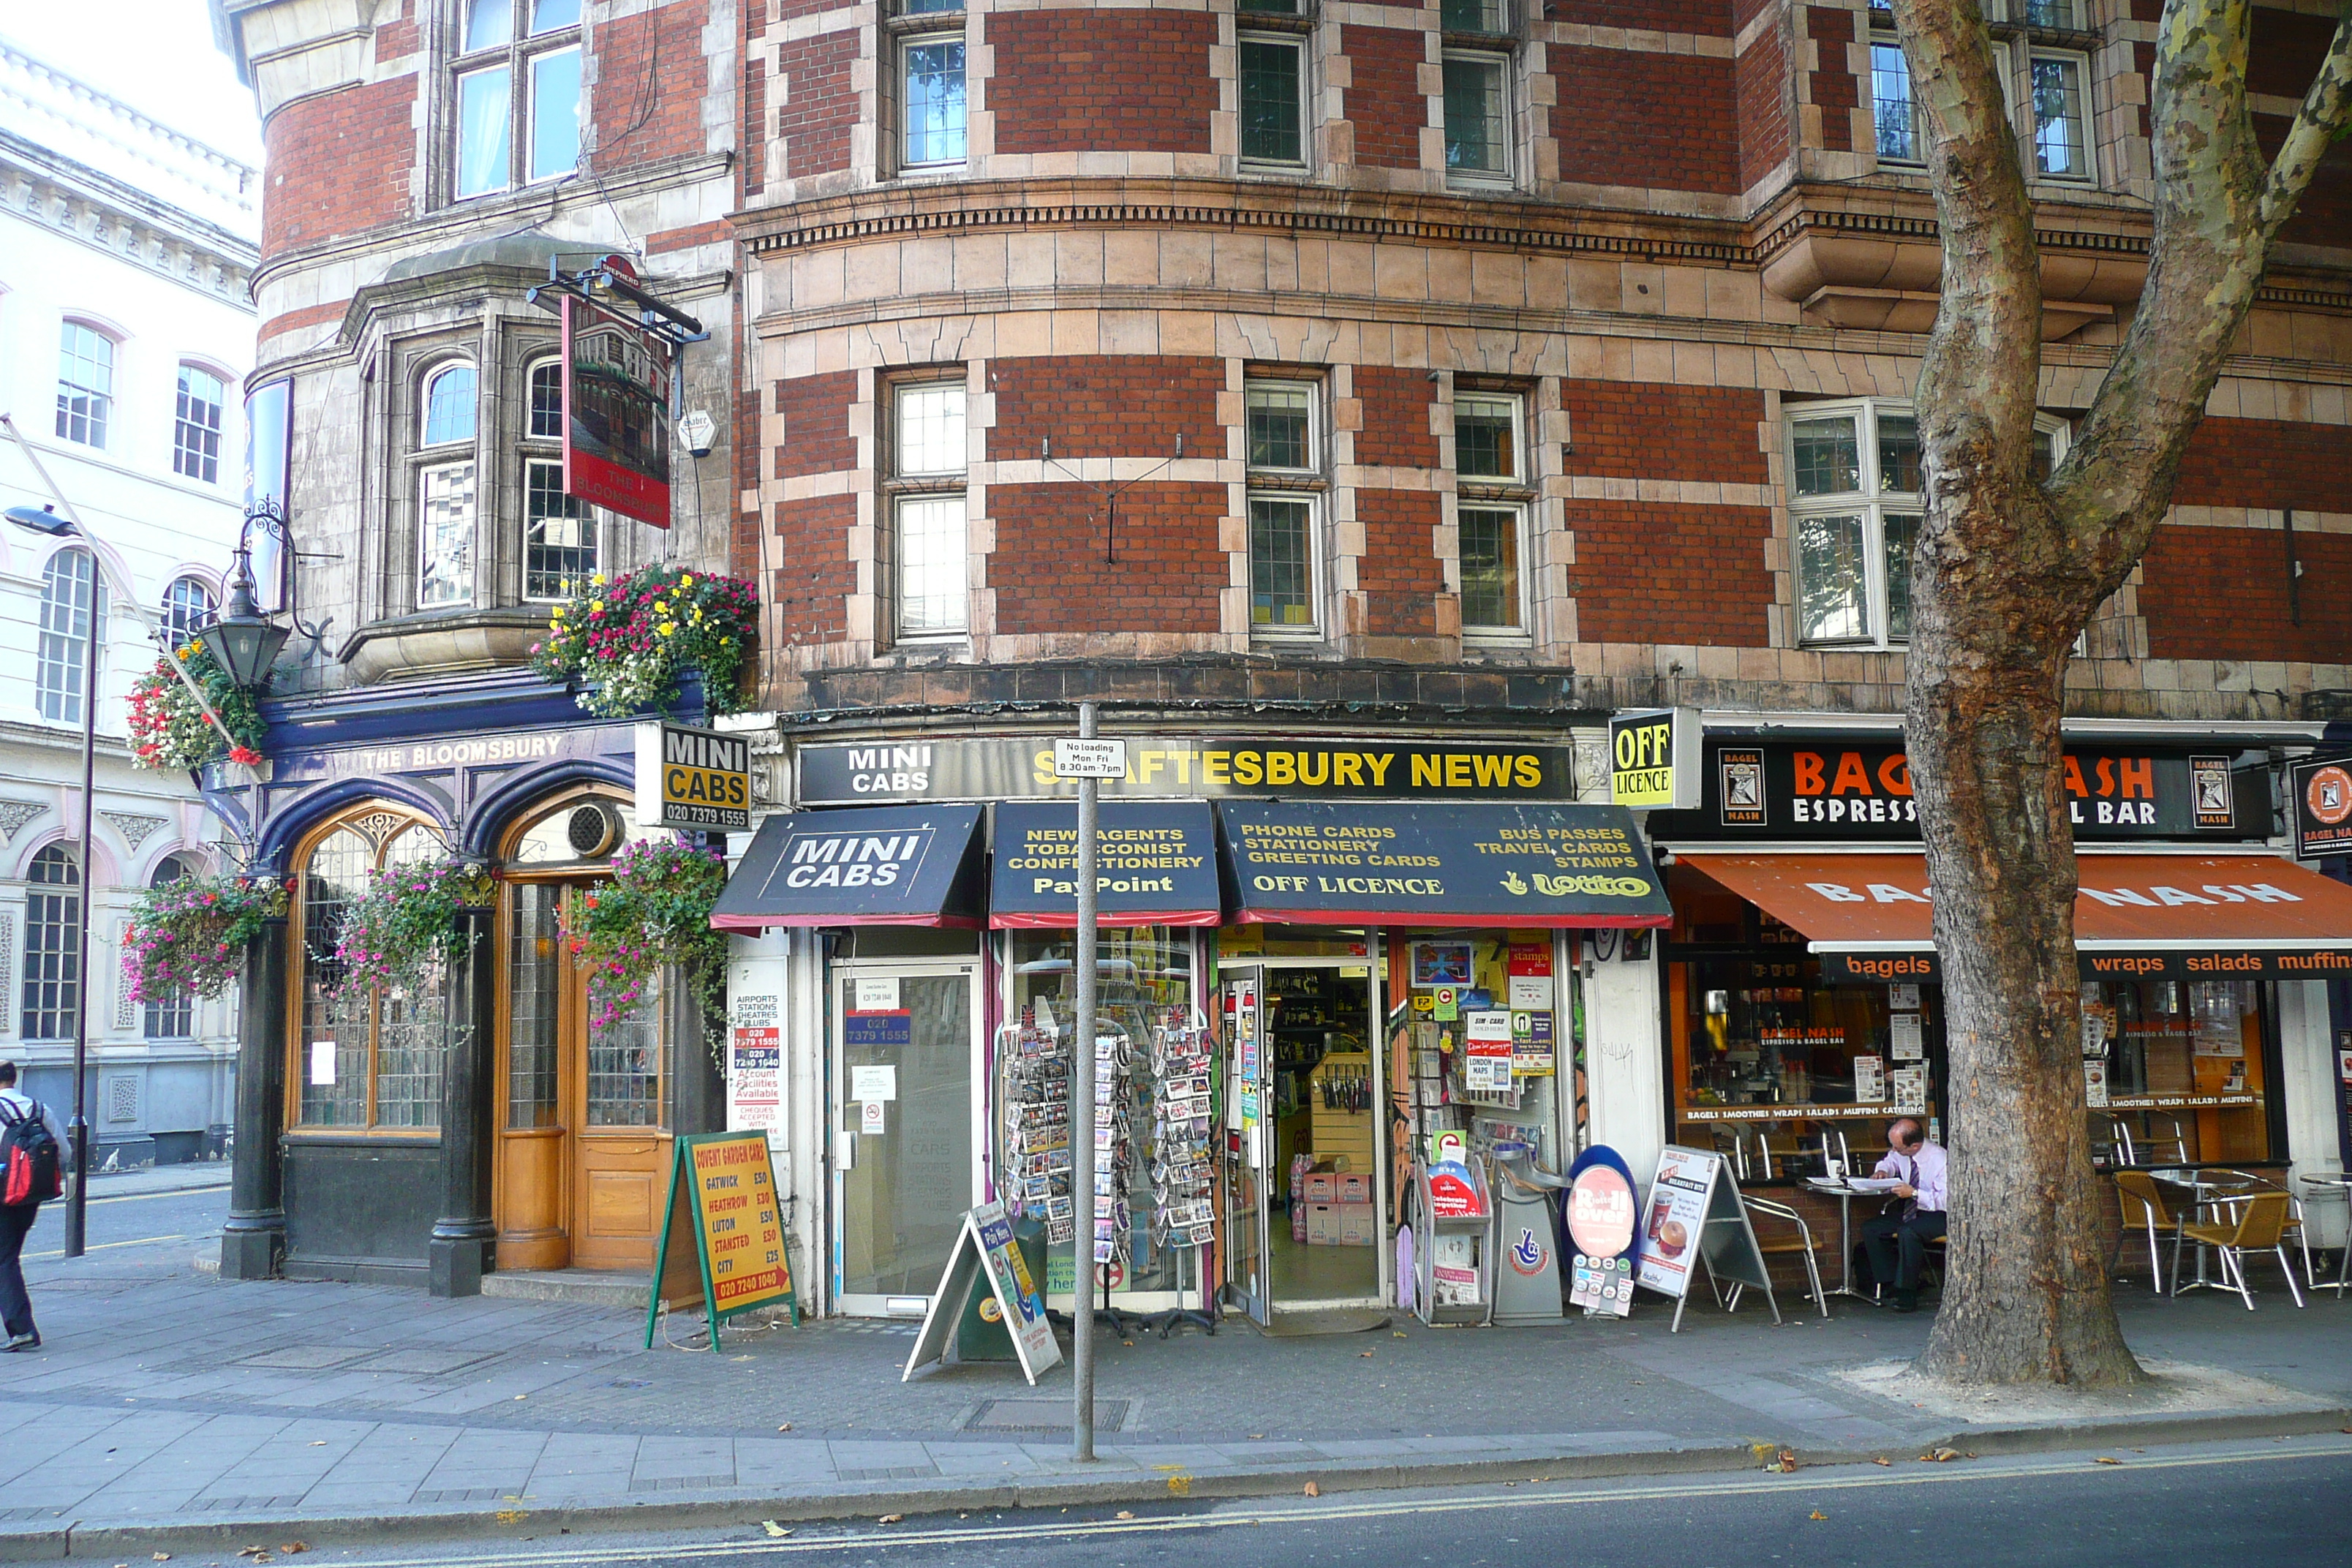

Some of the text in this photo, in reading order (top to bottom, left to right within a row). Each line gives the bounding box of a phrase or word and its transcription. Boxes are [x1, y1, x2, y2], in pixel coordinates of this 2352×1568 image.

[608, 470, 634, 491] THE
[576, 476, 664, 518] BLOOMSBURY
[364, 736, 562, 769] THE BLOOMSBURY
[666, 731, 744, 772] MINI
[1067, 743, 1114, 753] No loading
[1616, 723, 1670, 769] OFF
[848, 746, 931, 770] MINI
[1725, 754, 1758, 762] BAGEL
[2195, 761, 2225, 769] BAGEL
[1033, 750, 1542, 788] SAFTESBURY NEWS
[1793, 752, 2154, 797] BAG ASH
[667, 767, 745, 805] CABS
[853, 772, 930, 793] CABS
[1617, 770, 1669, 795] LICENCE
[667, 807, 745, 826] 020 7379 1555
[1728, 812, 1760, 820] NASH
[1793, 799, 1917, 823] ESPRESS
[2097, 801, 2156, 826] BAR
[1027, 829, 1184, 841] NEWAGENTS
[1241, 824, 1396, 839] PHONE CARDS
[1499, 829, 1625, 840] BUS PASSES
[2304, 827, 2352, 841] BAGEL NA
[792, 835, 921, 864] MINI
[1245, 838, 1381, 853] STATIONERY
[1474, 843, 1632, 854] TRAVEL CARDS
[1248, 851, 1441, 867] GREETING CARDS
[1555, 856, 1638, 868] STAMPS
[786, 863, 900, 888] CABS
[1254, 874, 1444, 895] OFF LICENCE
[2080, 883, 2304, 907] NASH
[1513, 952, 1549, 964] stamps
[2092, 952, 2352, 975] wraps salads muffin
[1847, 956, 1931, 978] bagels
[736, 995, 778, 1003] AIRPORTS
[867, 1019, 889, 1028] 020
[848, 1030, 908, 1040] 7379 1555
[1761, 1028, 1844, 1039] BAGEL NASH
[758, 1038, 778, 1046] 1555
[1469, 1058, 1492, 1066] LONDON
[738, 1070, 776, 1078] Account
[737, 1079, 777, 1088] Facilities
[2112, 1096, 2253, 1107] SMOOTHIES WRAPS SALADS MUFFINS
[1687, 1105, 1925, 1120] BAGELS SMOOTHIES WRAPS SALADS MUFFINS CATERING
[696, 1142, 764, 1169] COVENT GARDEN CARS
[911, 1143, 951, 1156] CARS
[706, 1175, 739, 1190] GATWICK
[754, 1172, 767, 1184] £50
[709, 1195, 747, 1213] HEATHROW
[757, 1192, 770, 1205] £30
[760, 1210, 774, 1224] £50
[1575, 1207, 1627, 1224] over
[712, 1218, 735, 1233] LUTON
[763, 1229, 776, 1243] £50
[715, 1235, 750, 1254] STANSTED
[766, 1250, 779, 1264] £25
[717, 1259, 734, 1274] CITY
[720, 1273, 777, 1297] 020 7240 1040
[1054, 1278, 1075, 1289] her
